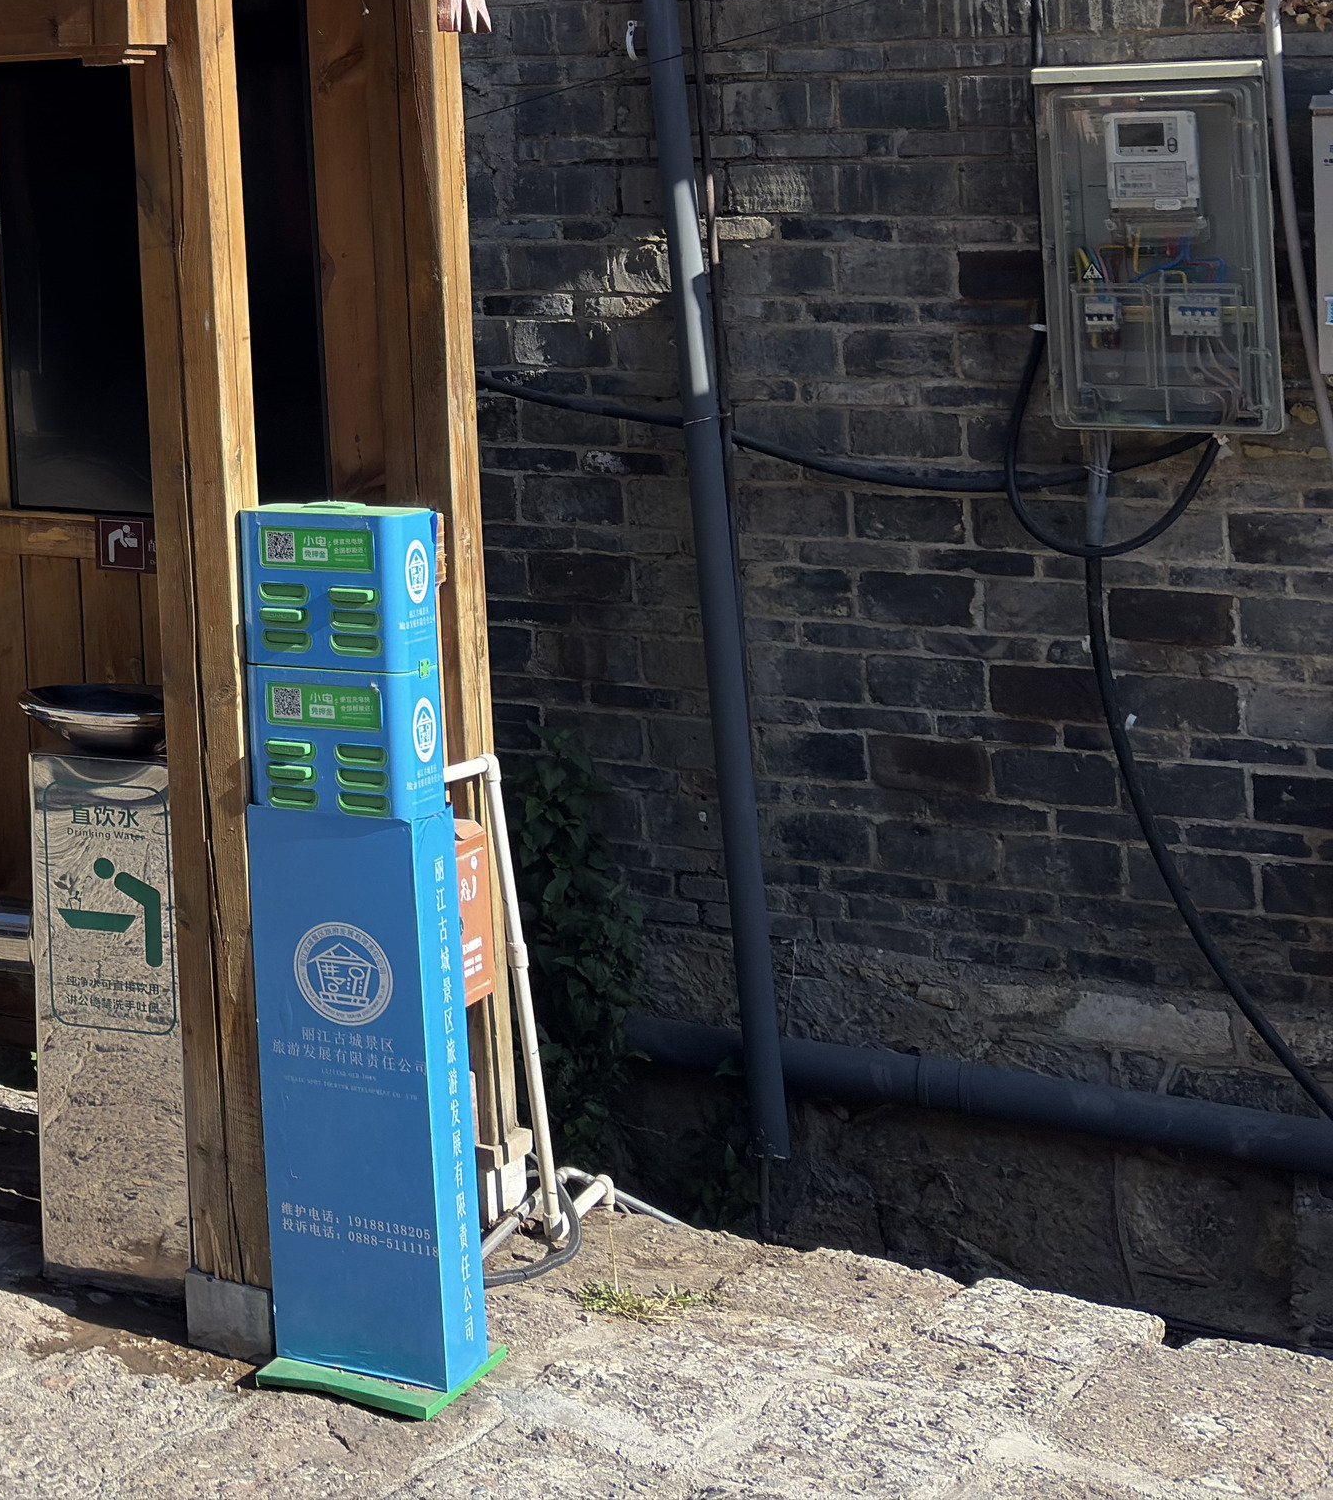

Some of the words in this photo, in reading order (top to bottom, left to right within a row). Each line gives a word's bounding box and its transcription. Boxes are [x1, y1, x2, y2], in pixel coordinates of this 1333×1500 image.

[303, 535, 327, 547] 小电
[304, 550, 326, 559] 免押金
[309, 692, 333, 704] 小电
[71, 804, 139, 828] 直饮水
[67, 827, 111, 840] Drinking
[113, 831, 145, 841] Water
[65, 975, 159, 995] 纯净水可直接饮用
[301, 1026, 395, 1053] 丽江古城景区
[272, 1038, 427, 1076] 旅游发展有限责任公司
[434, 856, 474, 1341] 丽江古城景区旅游发展有限责任公司
